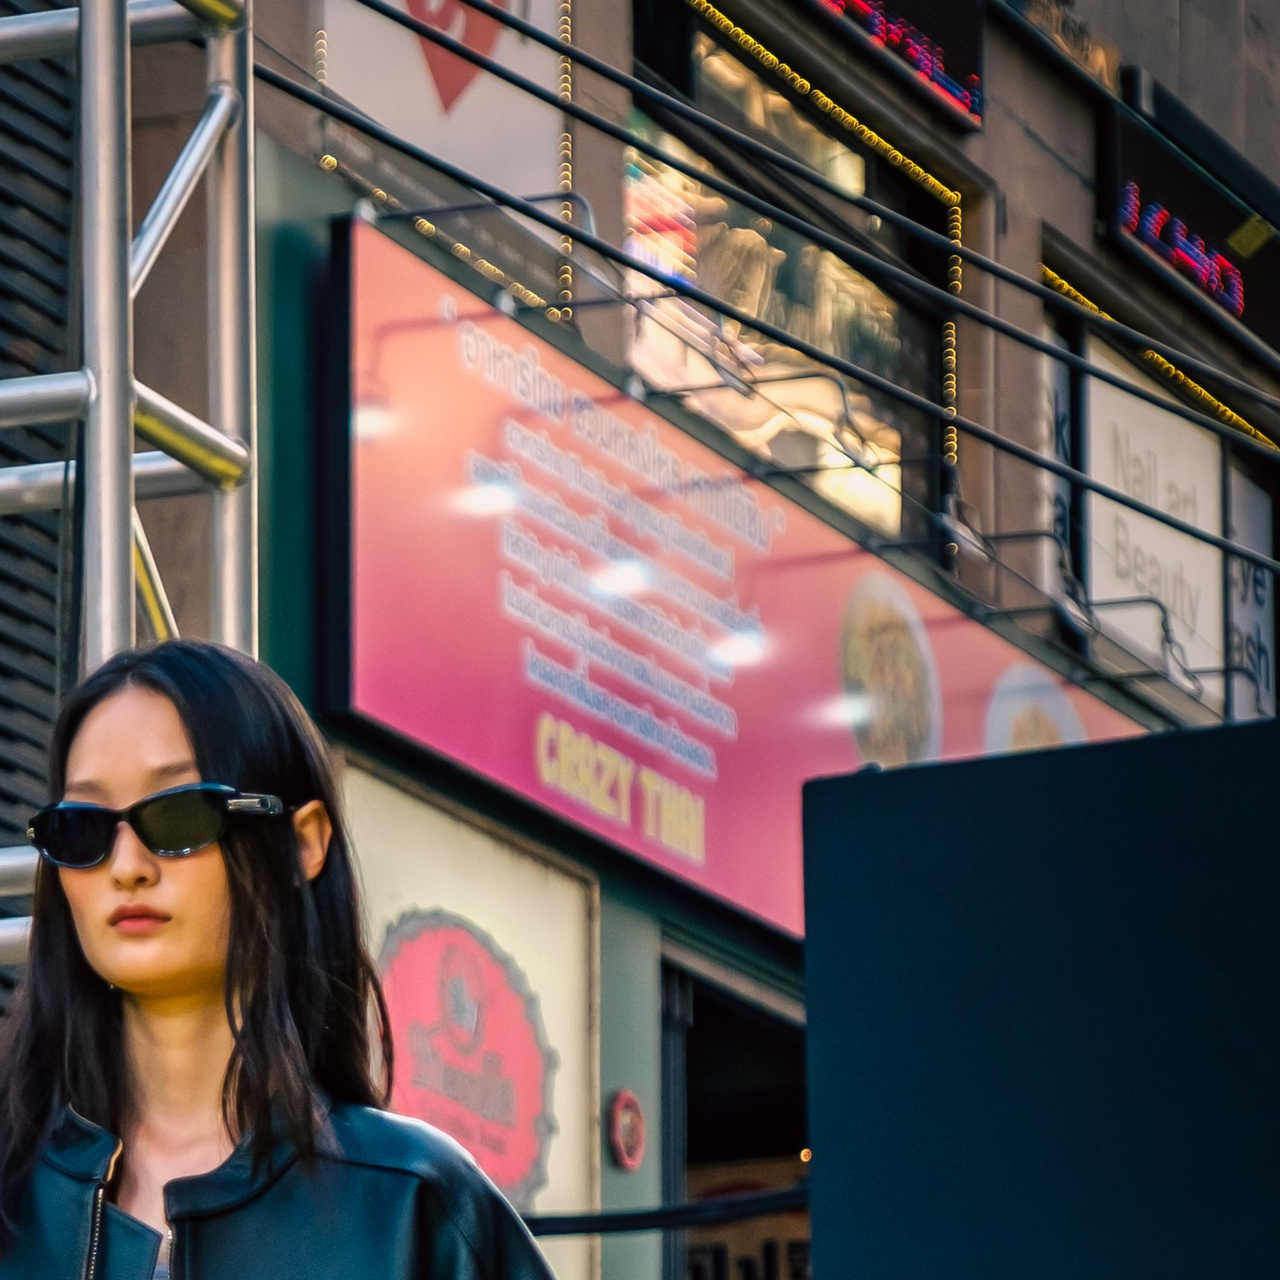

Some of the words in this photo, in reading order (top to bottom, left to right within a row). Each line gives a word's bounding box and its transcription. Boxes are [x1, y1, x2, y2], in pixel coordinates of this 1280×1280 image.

[1114, 514, 1202, 638] Beauty
[535, 712, 635, 827] CRAZY
[639, 765, 707, 864] THAI
